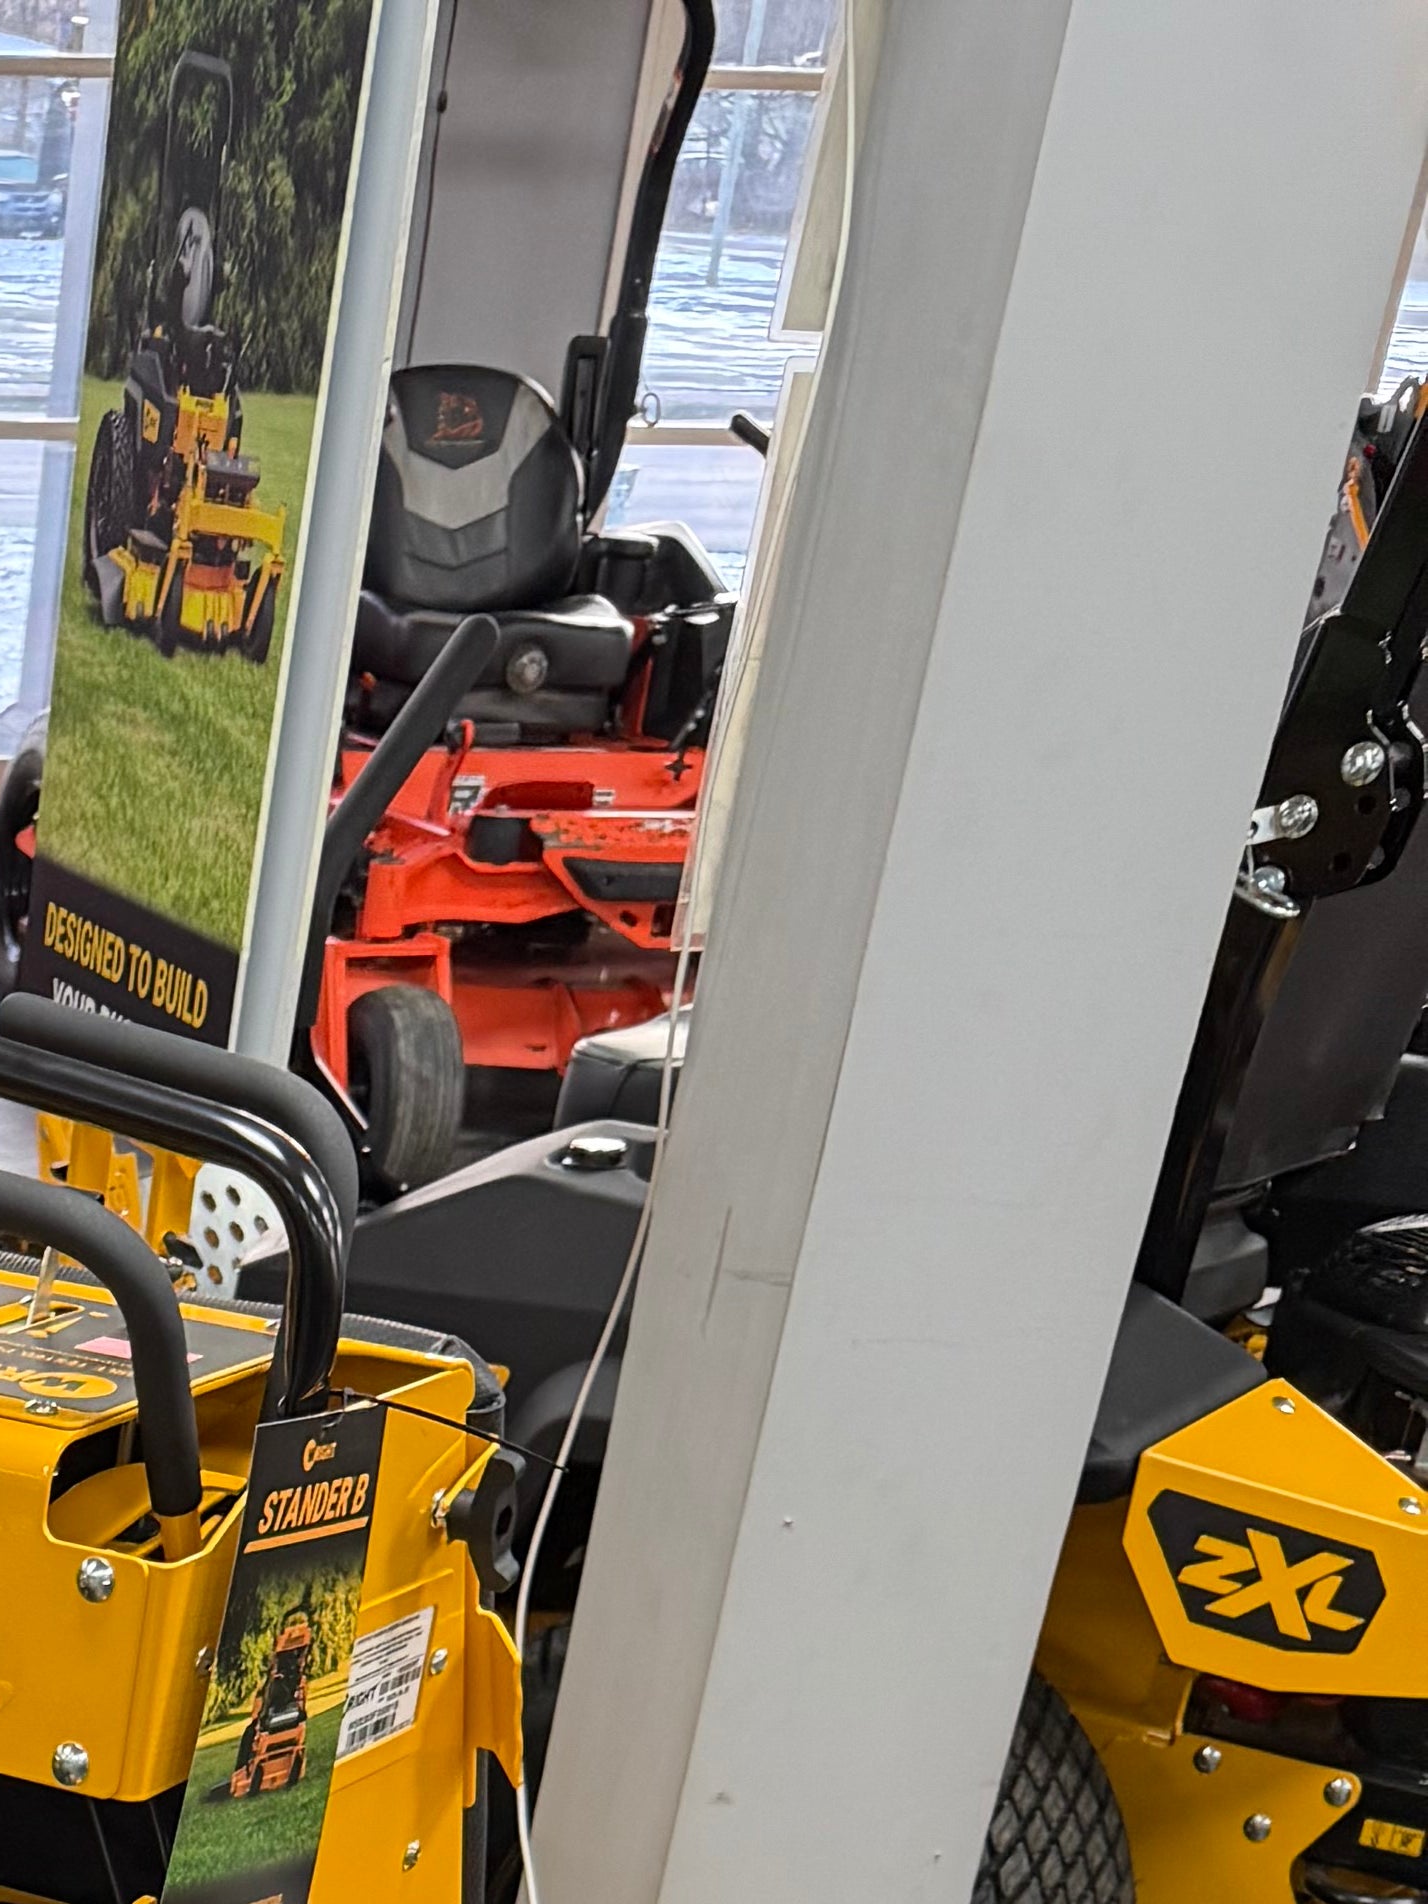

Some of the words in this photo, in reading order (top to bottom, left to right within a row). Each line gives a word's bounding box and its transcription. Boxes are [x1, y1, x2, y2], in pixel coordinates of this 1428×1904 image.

[43, 901, 126, 984] DESIGNED
[127, 943, 152, 1000] TO
[151, 957, 209, 1030] BUILD
[257, 1477, 353, 1535] STANDER
[350, 1473, 370, 1516] B
[1177, 1528, 1365, 1642] ZXL
[344, 1682, 379, 1717] RIGHT
